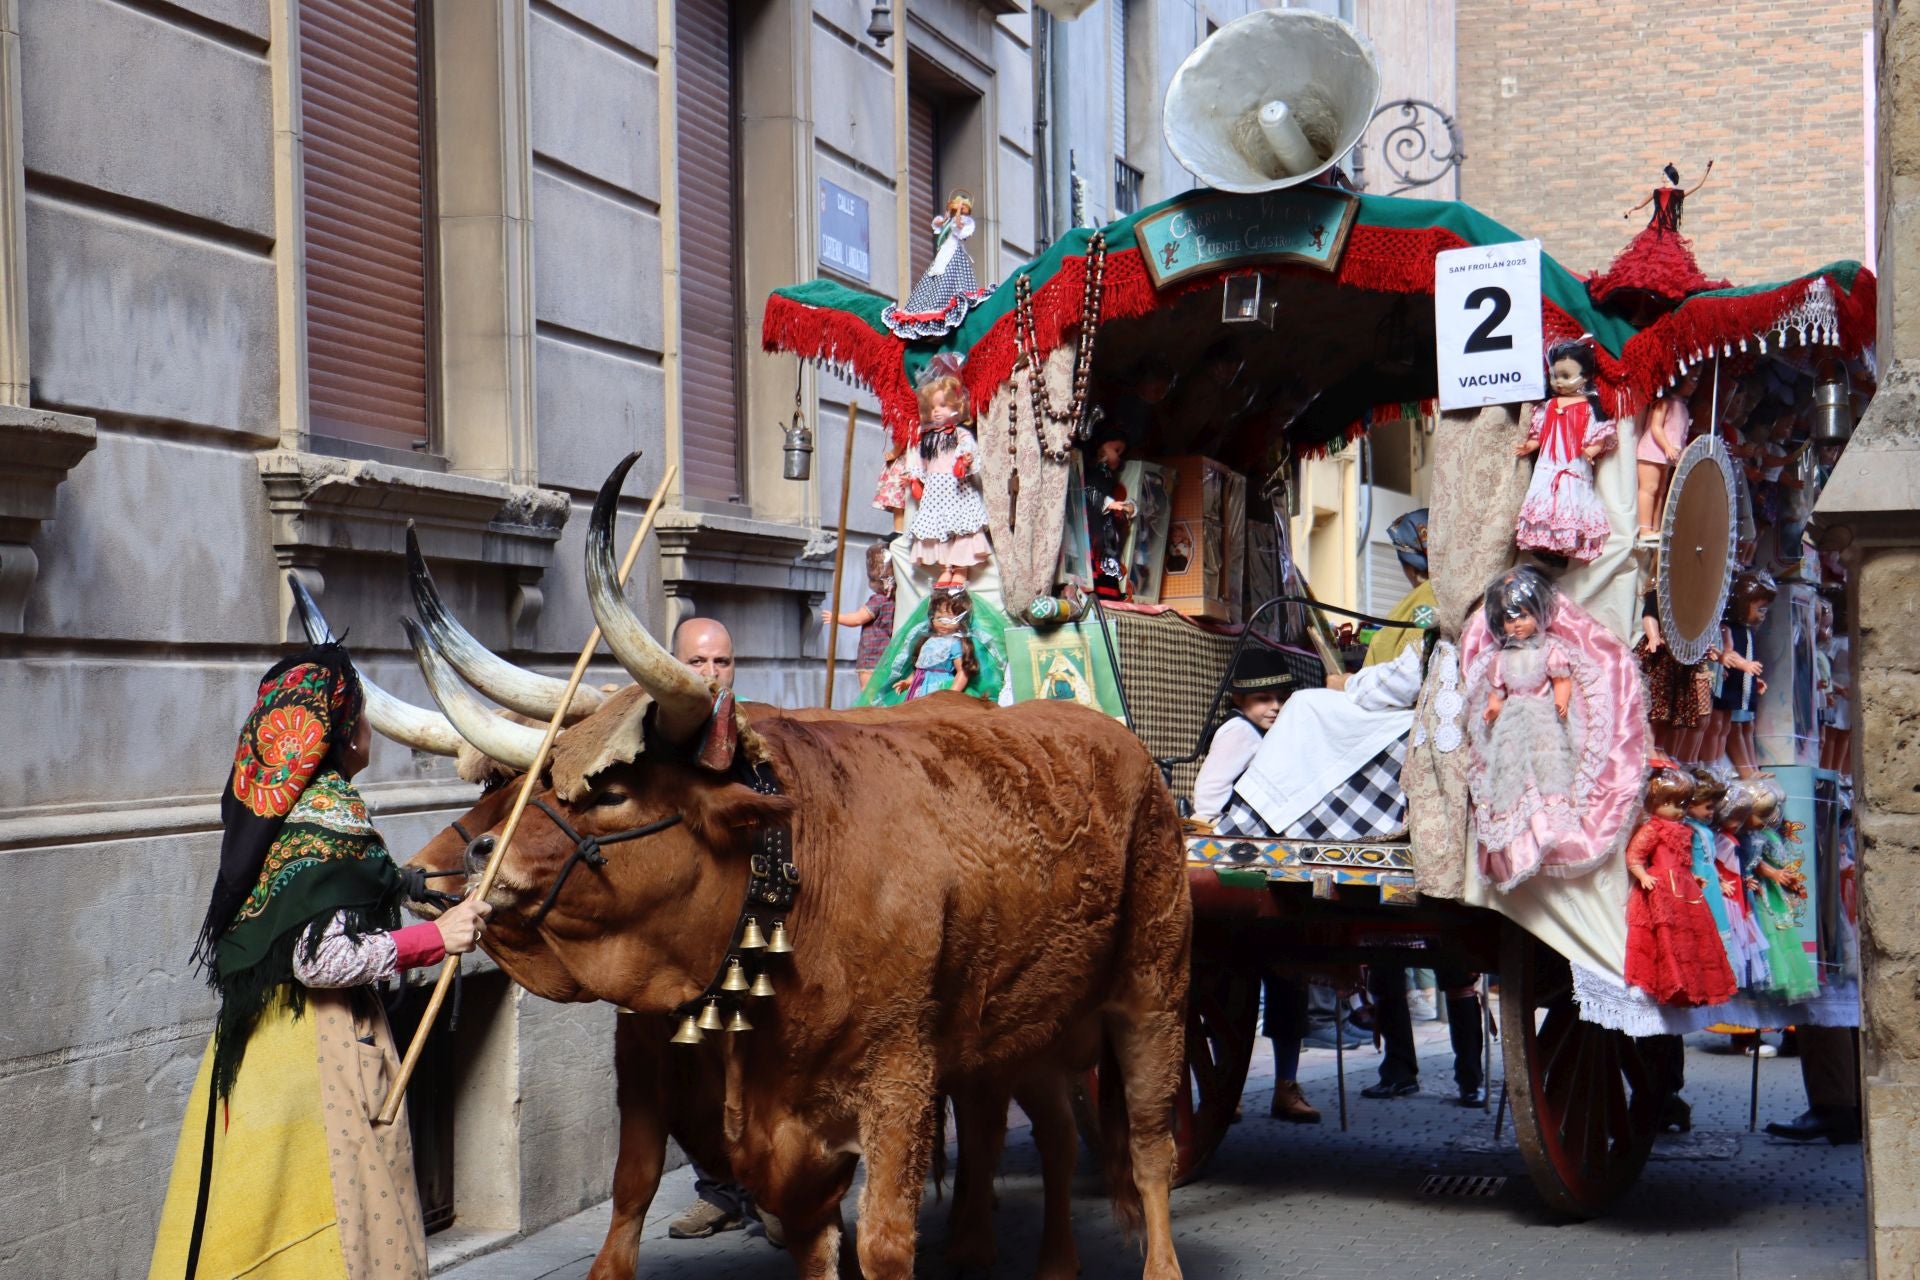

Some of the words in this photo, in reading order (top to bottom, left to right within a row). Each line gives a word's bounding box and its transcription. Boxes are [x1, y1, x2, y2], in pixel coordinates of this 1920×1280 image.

[837, 192, 855, 216] CALLE
[1448, 266, 1466, 274] SAN
[1506, 258, 1527, 268] 2025
[1463, 286, 1513, 354] 2
[1458, 371, 1522, 388] VACUNO
